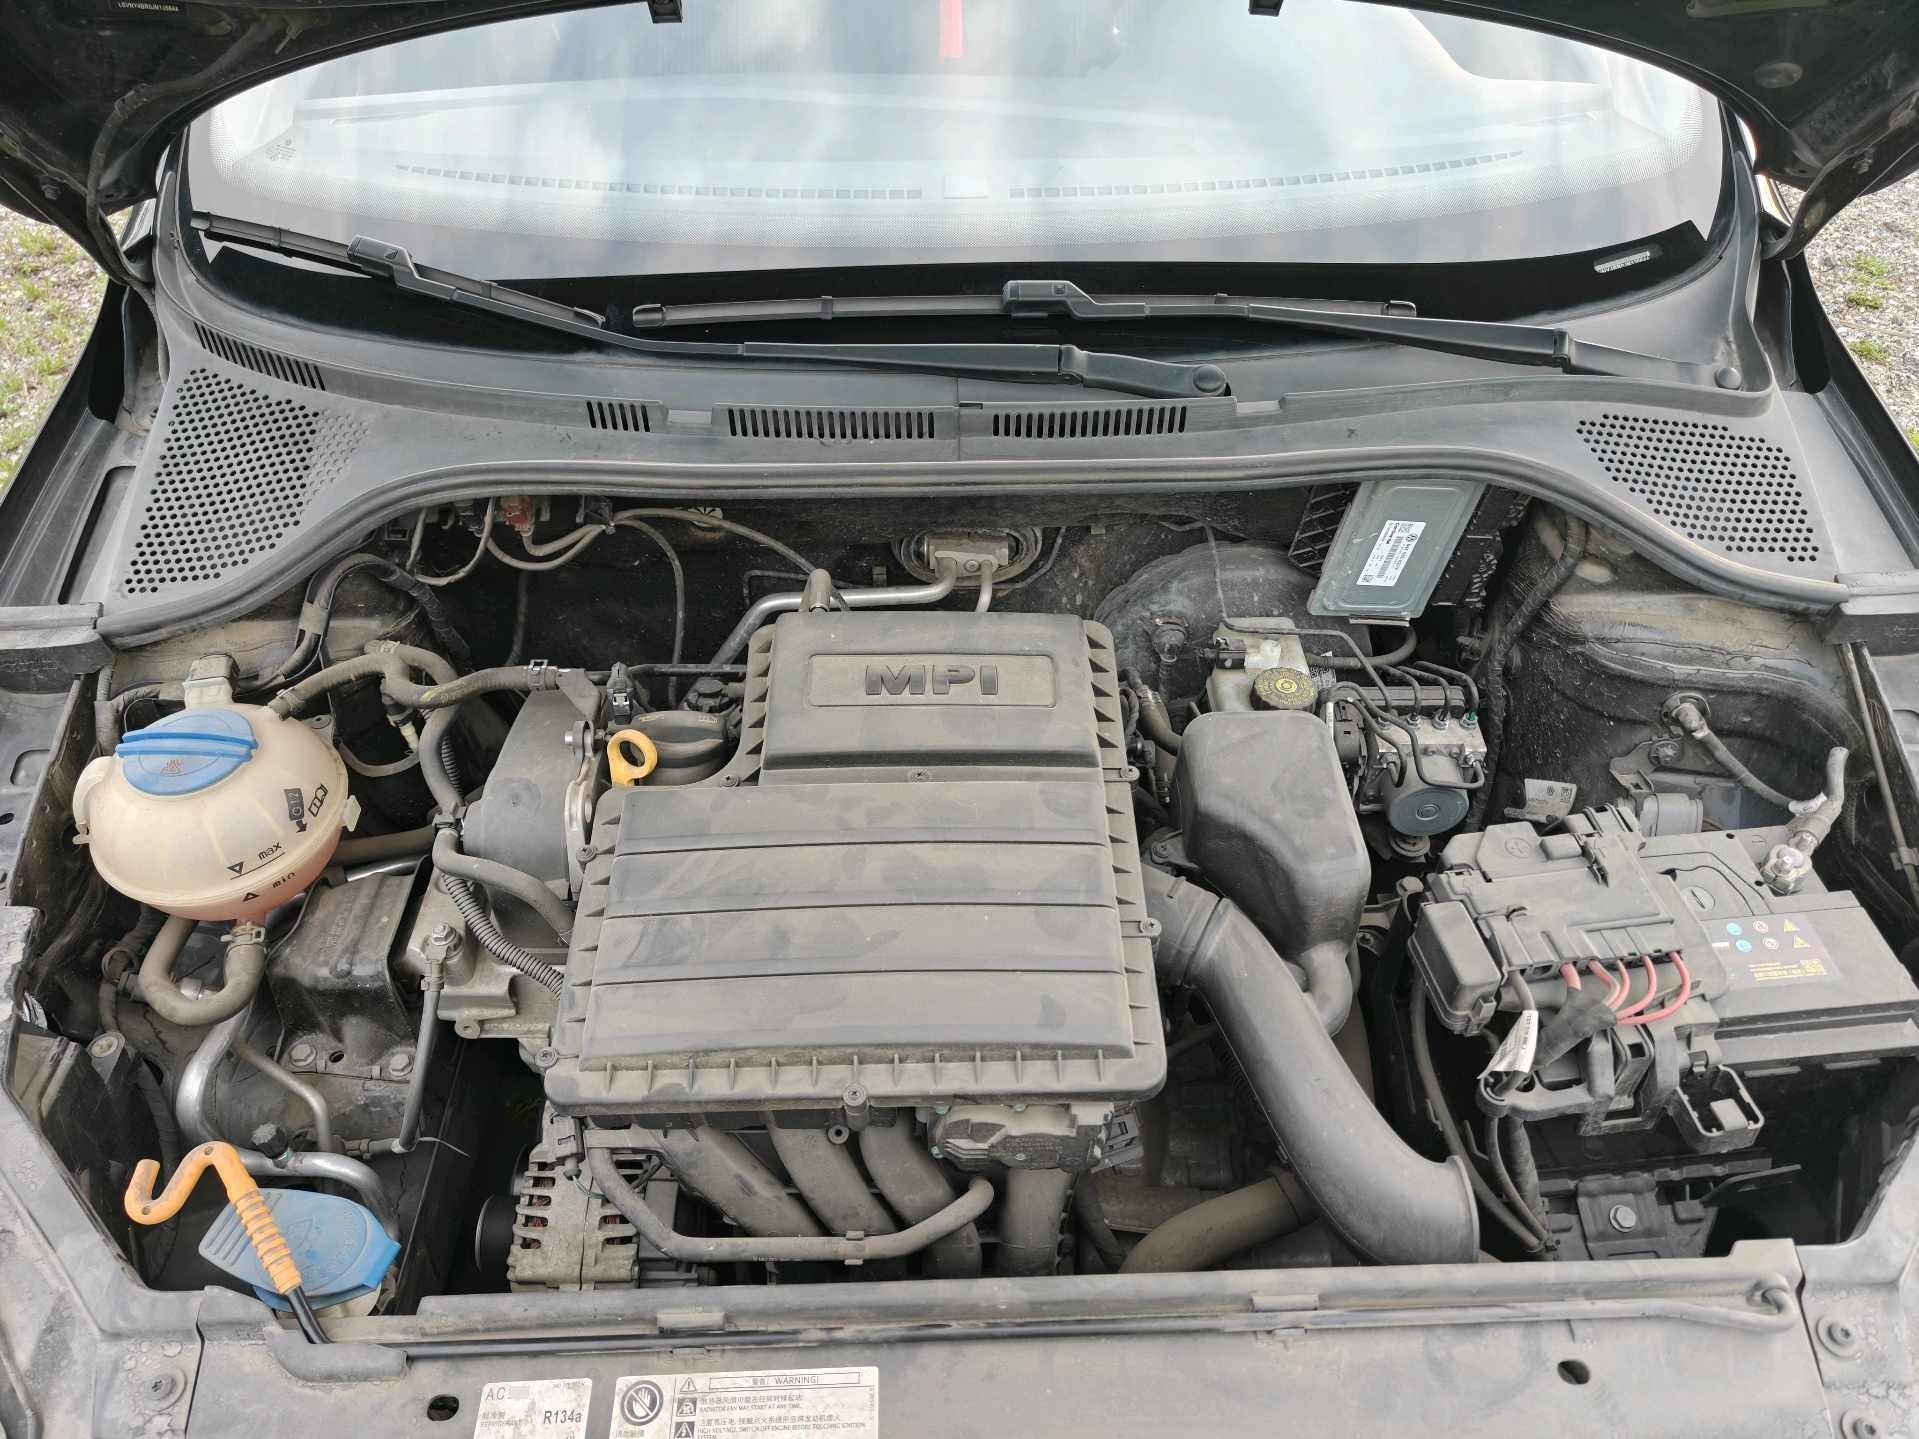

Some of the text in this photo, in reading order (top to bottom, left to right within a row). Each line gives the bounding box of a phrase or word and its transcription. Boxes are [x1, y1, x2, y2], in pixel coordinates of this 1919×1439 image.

[865, 664, 998, 696] MPI
[258, 841, 282, 861] max
[272, 871, 297, 889] min
[543, 1409, 583, 1425] R134a
